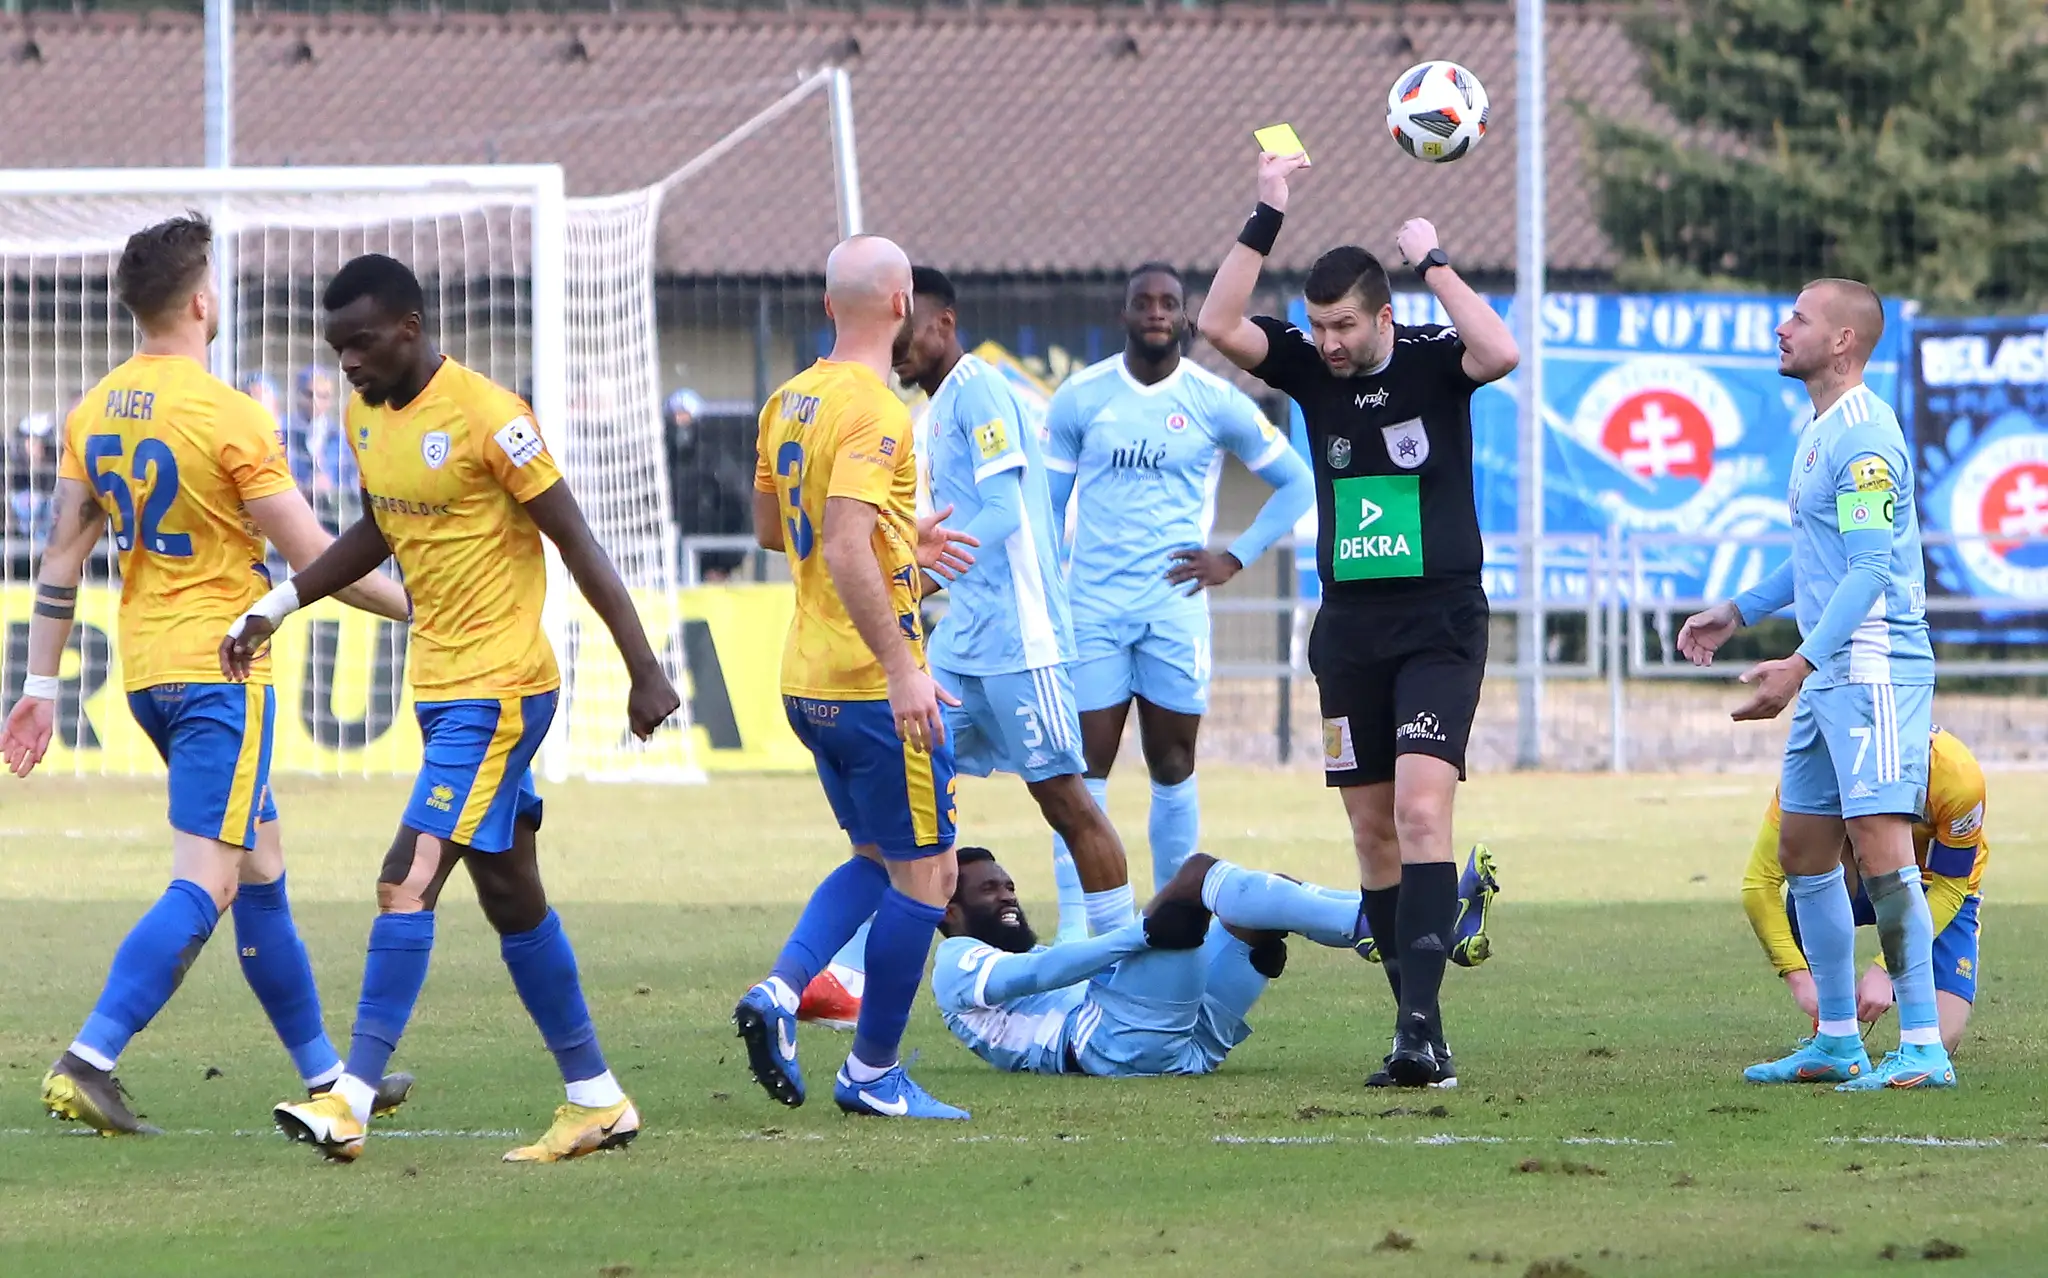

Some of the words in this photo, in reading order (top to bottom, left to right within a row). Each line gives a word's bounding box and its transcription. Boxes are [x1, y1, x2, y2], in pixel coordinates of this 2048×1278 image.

[1921, 333, 2048, 386] BELAS
[104, 389, 155, 420] PAJER
[84, 434, 193, 557] 52
[777, 441, 814, 561] 3
[1340, 534, 1411, 560] DEKRA
[1015, 705, 1043, 748] 3
[1849, 727, 1872, 775] 7
